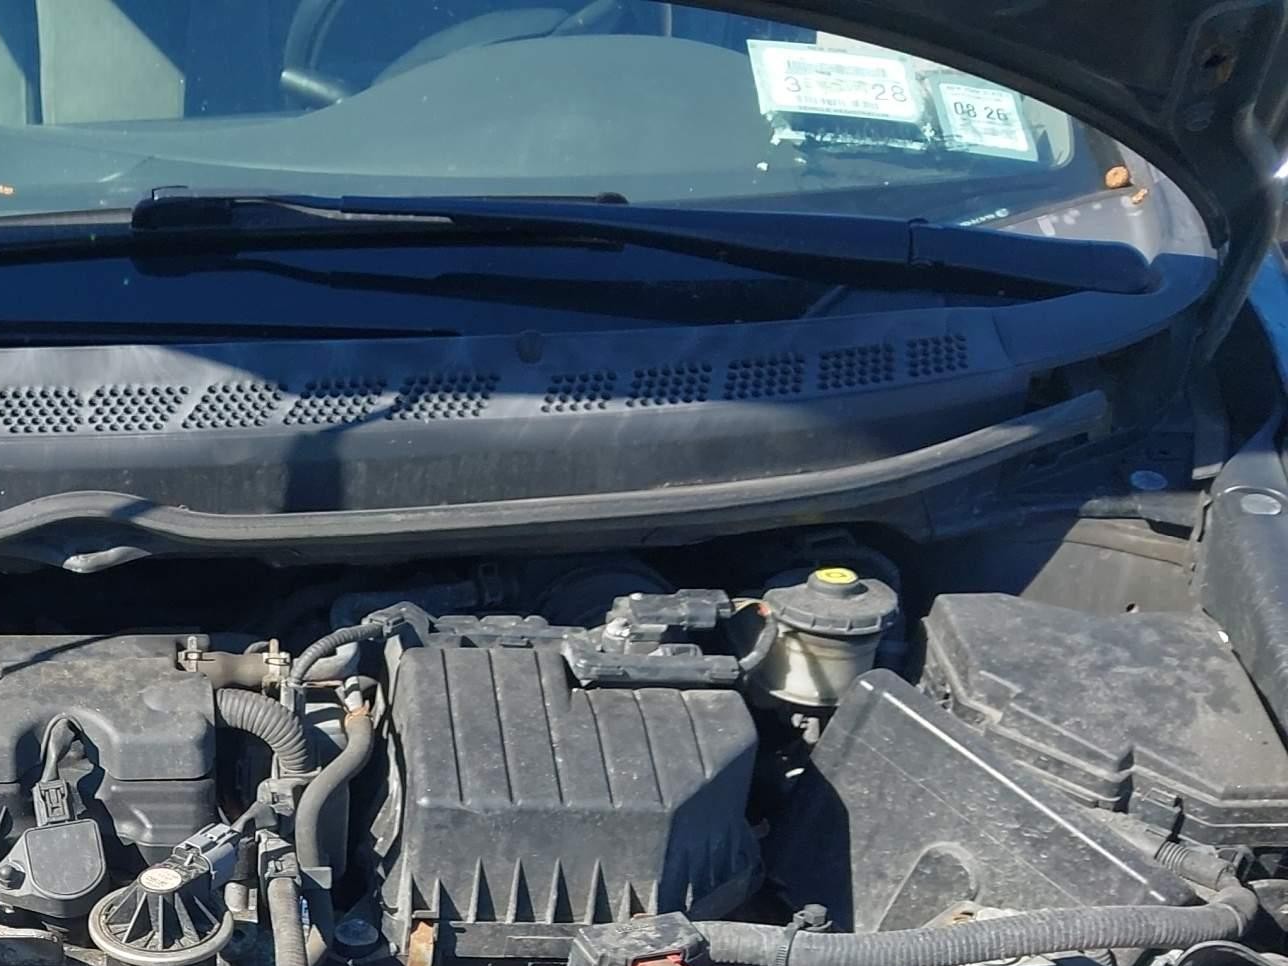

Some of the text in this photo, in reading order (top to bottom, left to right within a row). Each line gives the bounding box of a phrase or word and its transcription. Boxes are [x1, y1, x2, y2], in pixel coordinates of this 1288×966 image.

[784, 75, 801, 93] 3
[872, 83, 907, 103] 28
[953, 101, 1009, 121] 08 26
